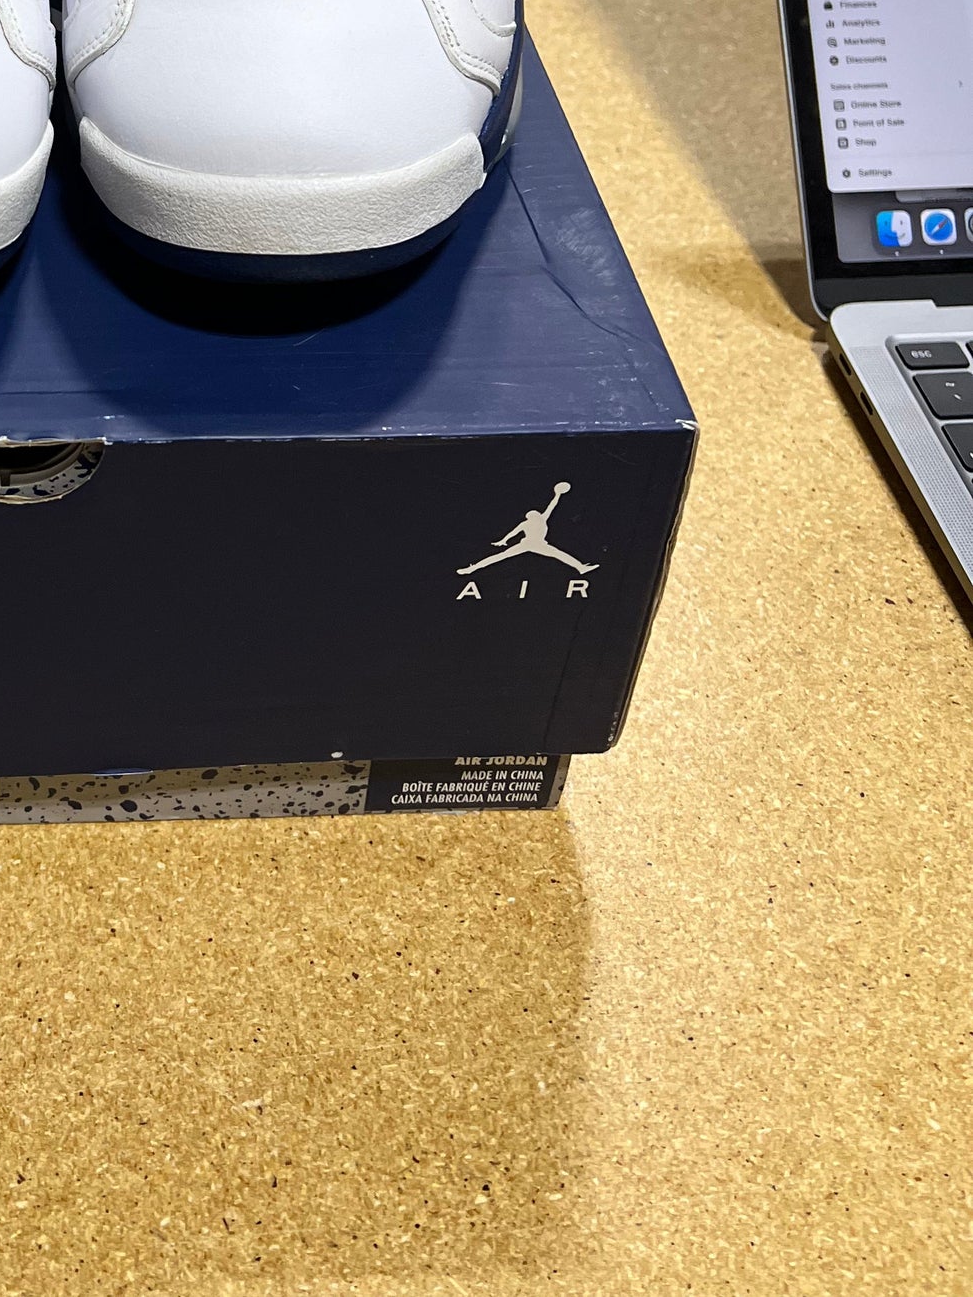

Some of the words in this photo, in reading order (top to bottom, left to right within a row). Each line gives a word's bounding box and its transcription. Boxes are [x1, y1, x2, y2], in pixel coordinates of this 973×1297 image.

[839, 0, 877, 9] Finances
[841, 18, 880, 29] Analytics
[843, 36, 886, 47] Marketing
[845, 55, 888, 65] Discounts
[830, 82, 852, 91] Sales
[850, 100, 878, 110] Online
[879, 99, 902, 109] Store
[852, 118, 875, 128] Point
[876, 118, 885, 127] of
[886, 118, 905, 127] Sale
[854, 137, 877, 147] Shop
[858, 167, 893, 178] Settings
[456, 578, 590, 601] AIR
[454, 756, 481, 766] AIR
[485, 755, 548, 767] JORDAN
[461, 770, 493, 781] MADE
[495, 770, 508, 780] IN
[510, 770, 544, 781] CHINA
[402, 780, 433, 793] BOÎTE
[435, 781, 490, 793] FABRIQUÉ
[490, 782, 506, 792] EN
[508, 781, 542, 792] CHINE
[391, 793, 423, 805] CAIXA
[425, 793, 484, 804] FABRICADA
[487, 792, 502, 803] NA
[505, 792, 538, 803] CHINA
